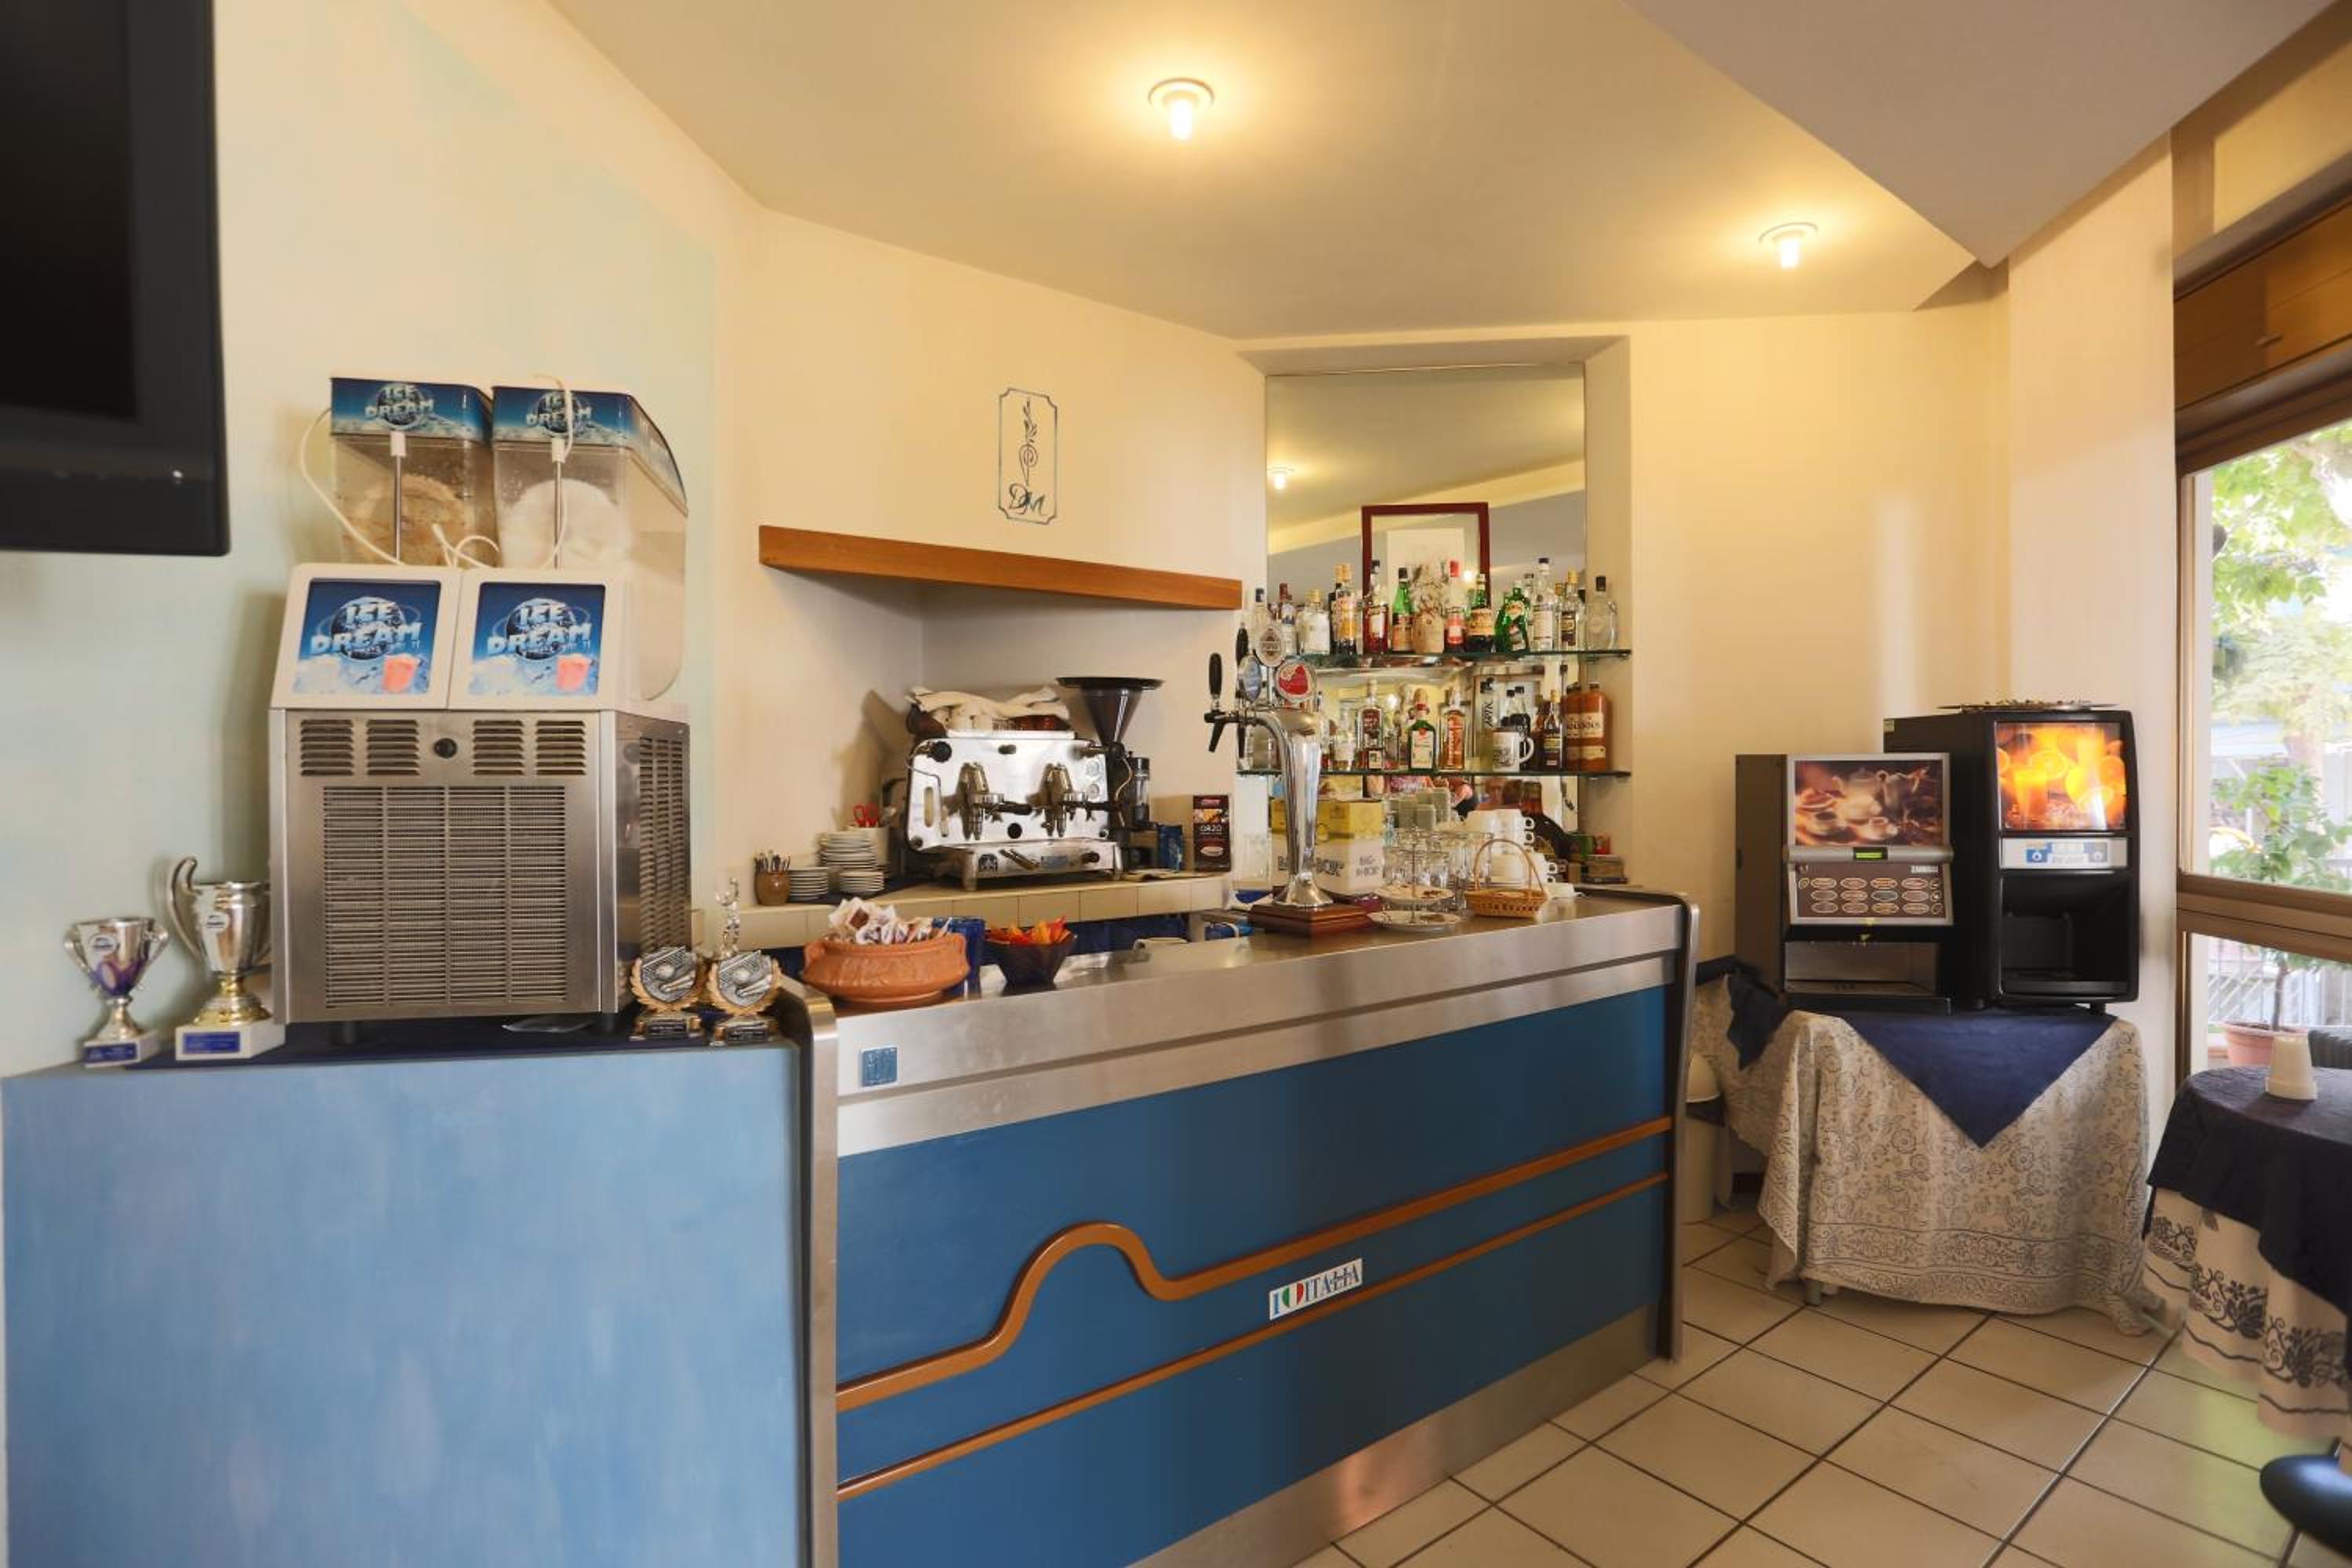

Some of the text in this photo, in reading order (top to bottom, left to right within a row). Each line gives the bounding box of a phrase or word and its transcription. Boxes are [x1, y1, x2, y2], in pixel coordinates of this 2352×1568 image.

[384, 383, 416, 401] ICE
[365, 398, 434, 420] DREAM
[526, 406, 592, 426] DREM
[346, 602, 397, 626] ICE
[519, 603, 567, 627] ICE
[310, 622, 423, 655] DREAM
[487, 622, 593, 655] DREAM
[1305, 1265, 1359, 1301] ITALIA
